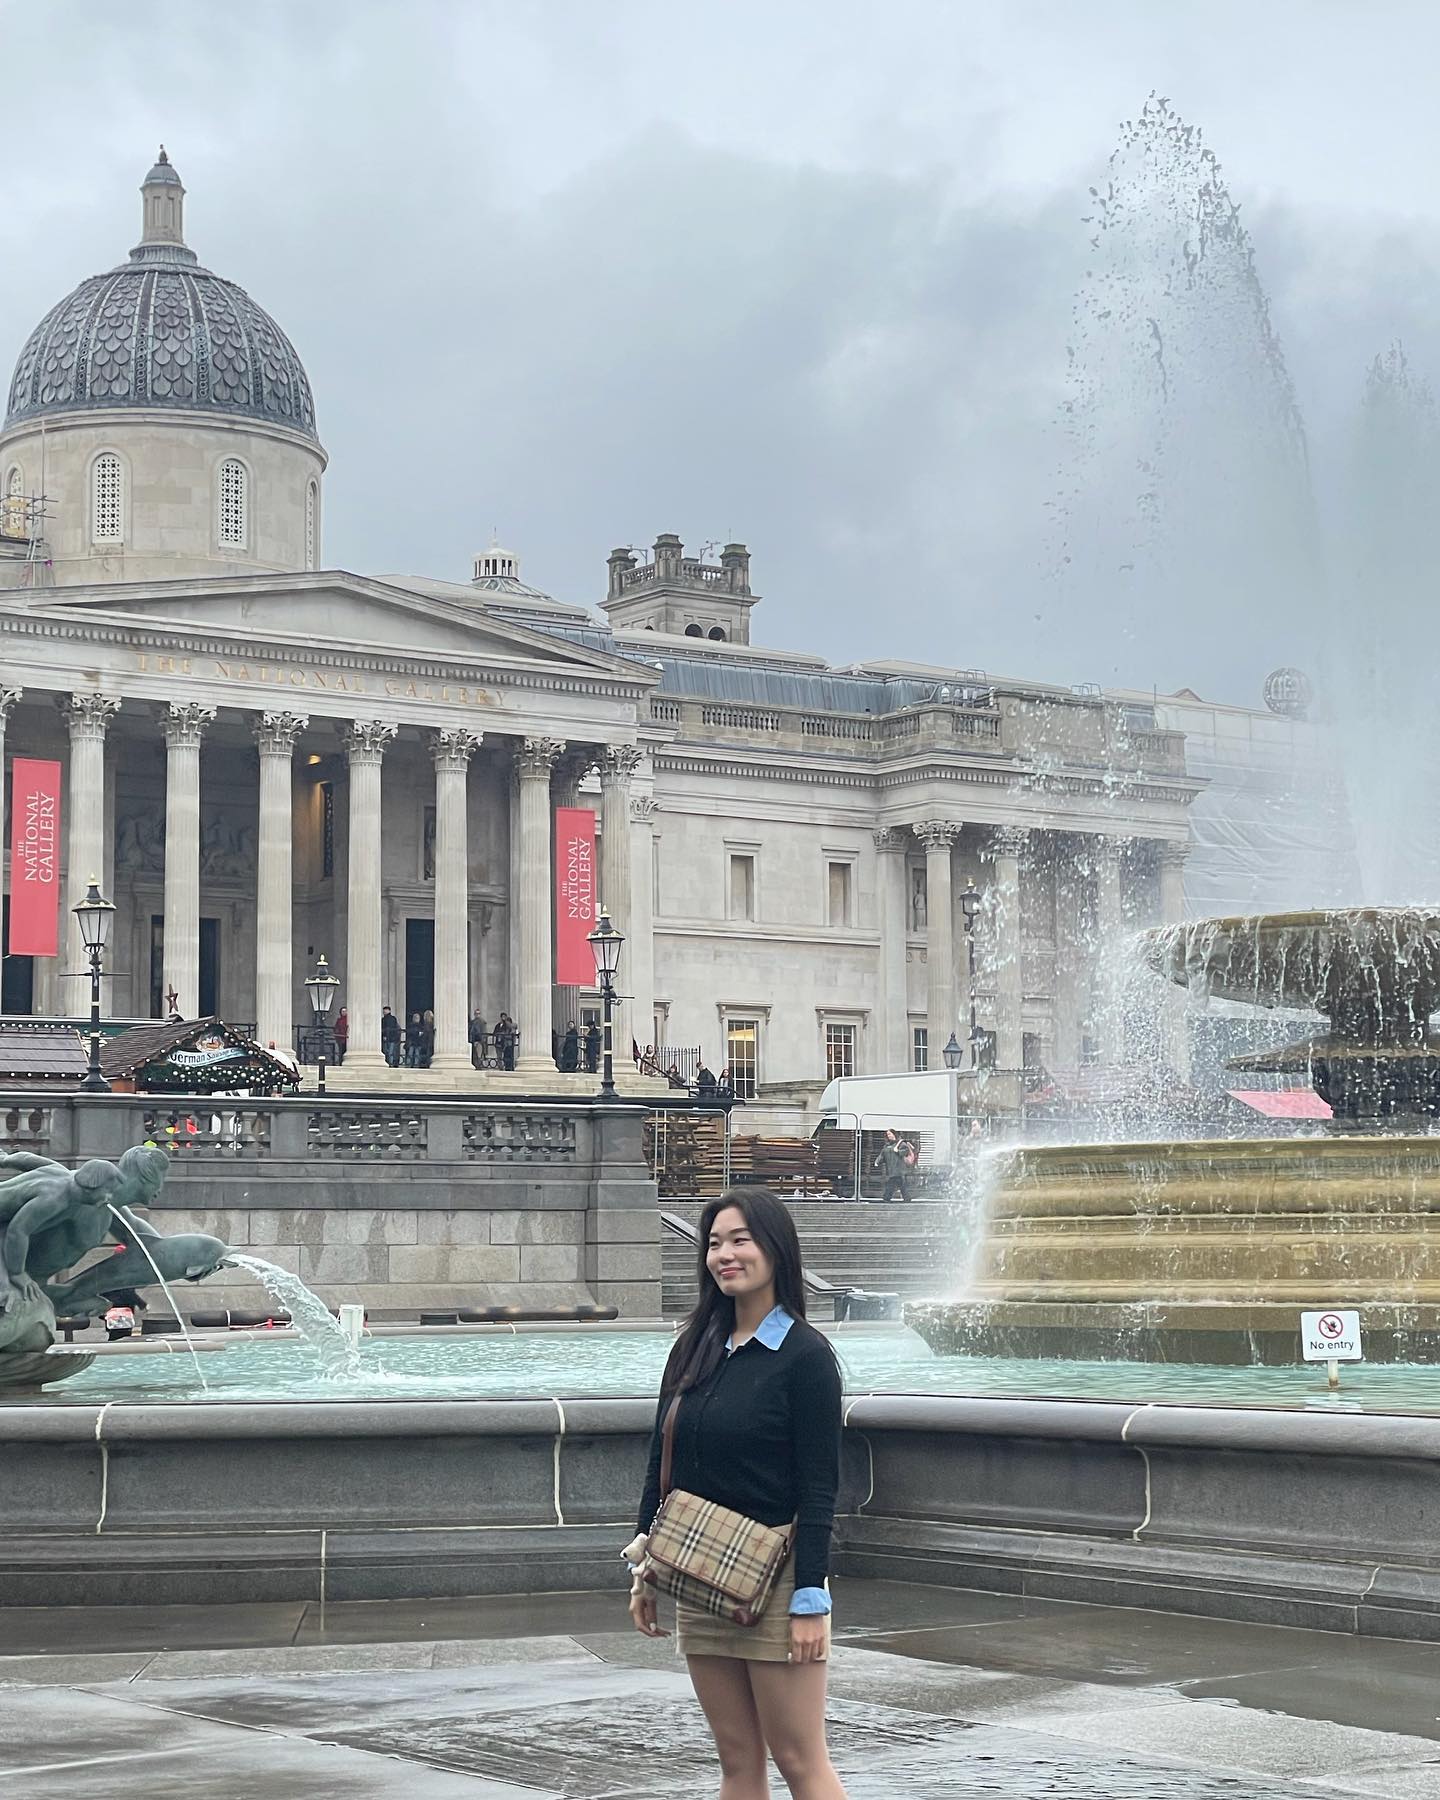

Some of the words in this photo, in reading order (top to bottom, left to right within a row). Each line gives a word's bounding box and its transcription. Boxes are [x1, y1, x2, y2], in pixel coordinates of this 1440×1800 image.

[136, 653, 193, 674] THE
[216, 661, 366, 693] NATIONAL
[384, 678, 508, 707] GALLERY
[25, 791, 38, 881] NATIONAL
[39, 792, 54, 883] GALLERY
[568, 837, 578, 918] NATIONAL
[580, 838, 591, 919] GALLERY
[1310, 1341, 1325, 1350] No
[1327, 1341, 1354, 1351] entry
